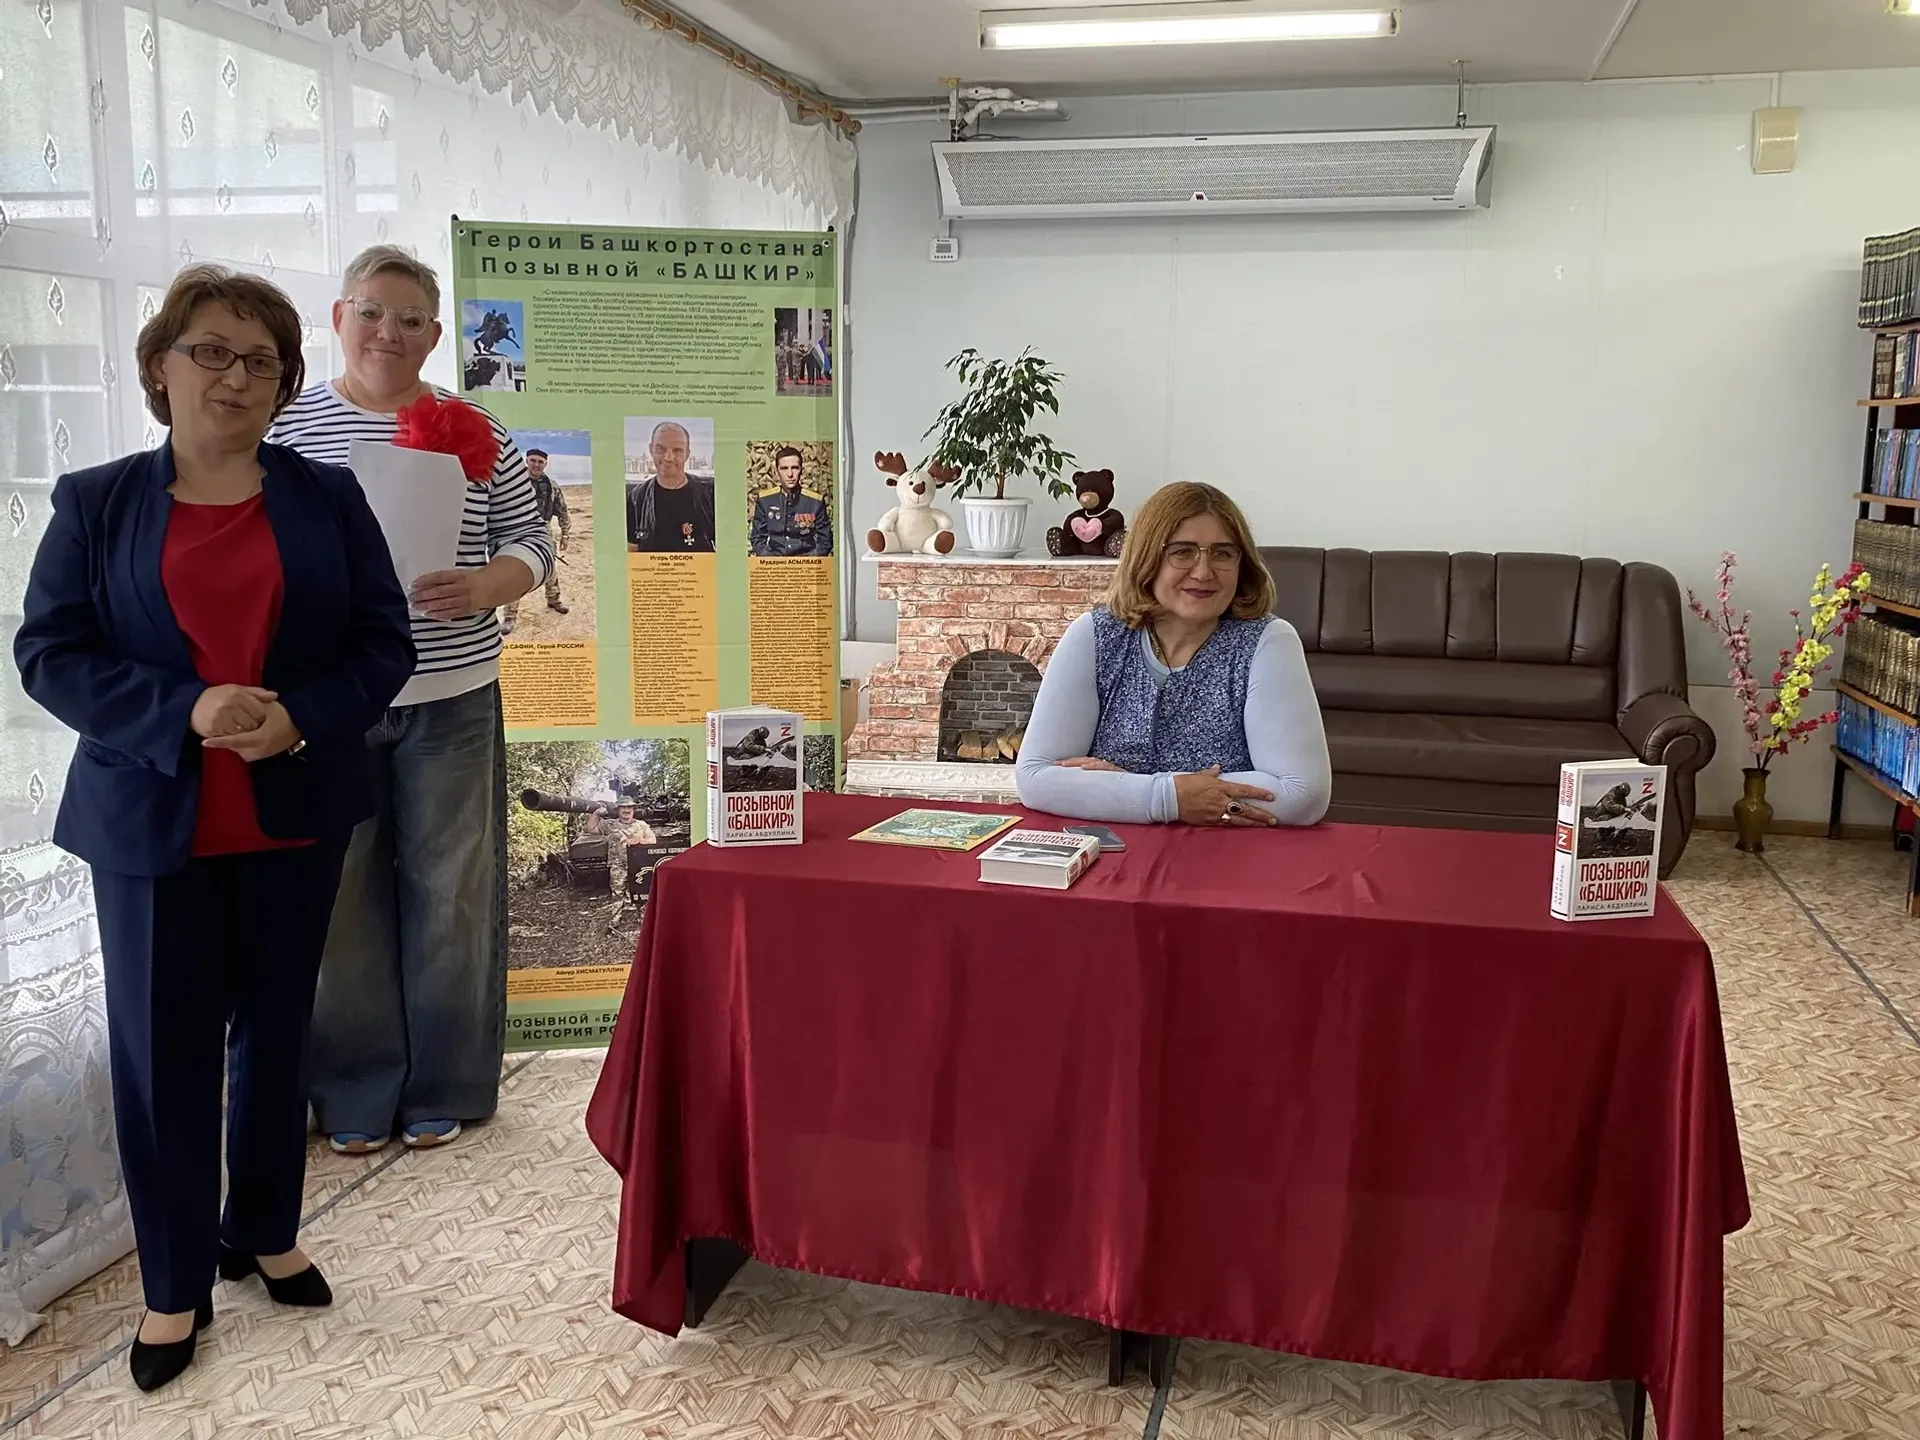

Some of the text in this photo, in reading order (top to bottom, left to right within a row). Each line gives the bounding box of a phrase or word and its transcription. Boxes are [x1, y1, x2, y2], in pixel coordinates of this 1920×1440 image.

[471, 230, 823, 257] Герои Башкортостана
[481, 256, 814, 281] Позывной «БАШКИР»
[781, 727, 791, 737] Z
[1641, 783, 1653, 794] Z
[727, 792, 795, 812] ПОЗЫВНОЙ
[727, 812, 794, 830] «БАШКИР»
[1580, 858, 1650, 882] ПОЗЫВНОЙ
[1579, 881, 1648, 902] «БАШКИР»
[522, 1027, 592, 1040] ИСТОРИЯ
